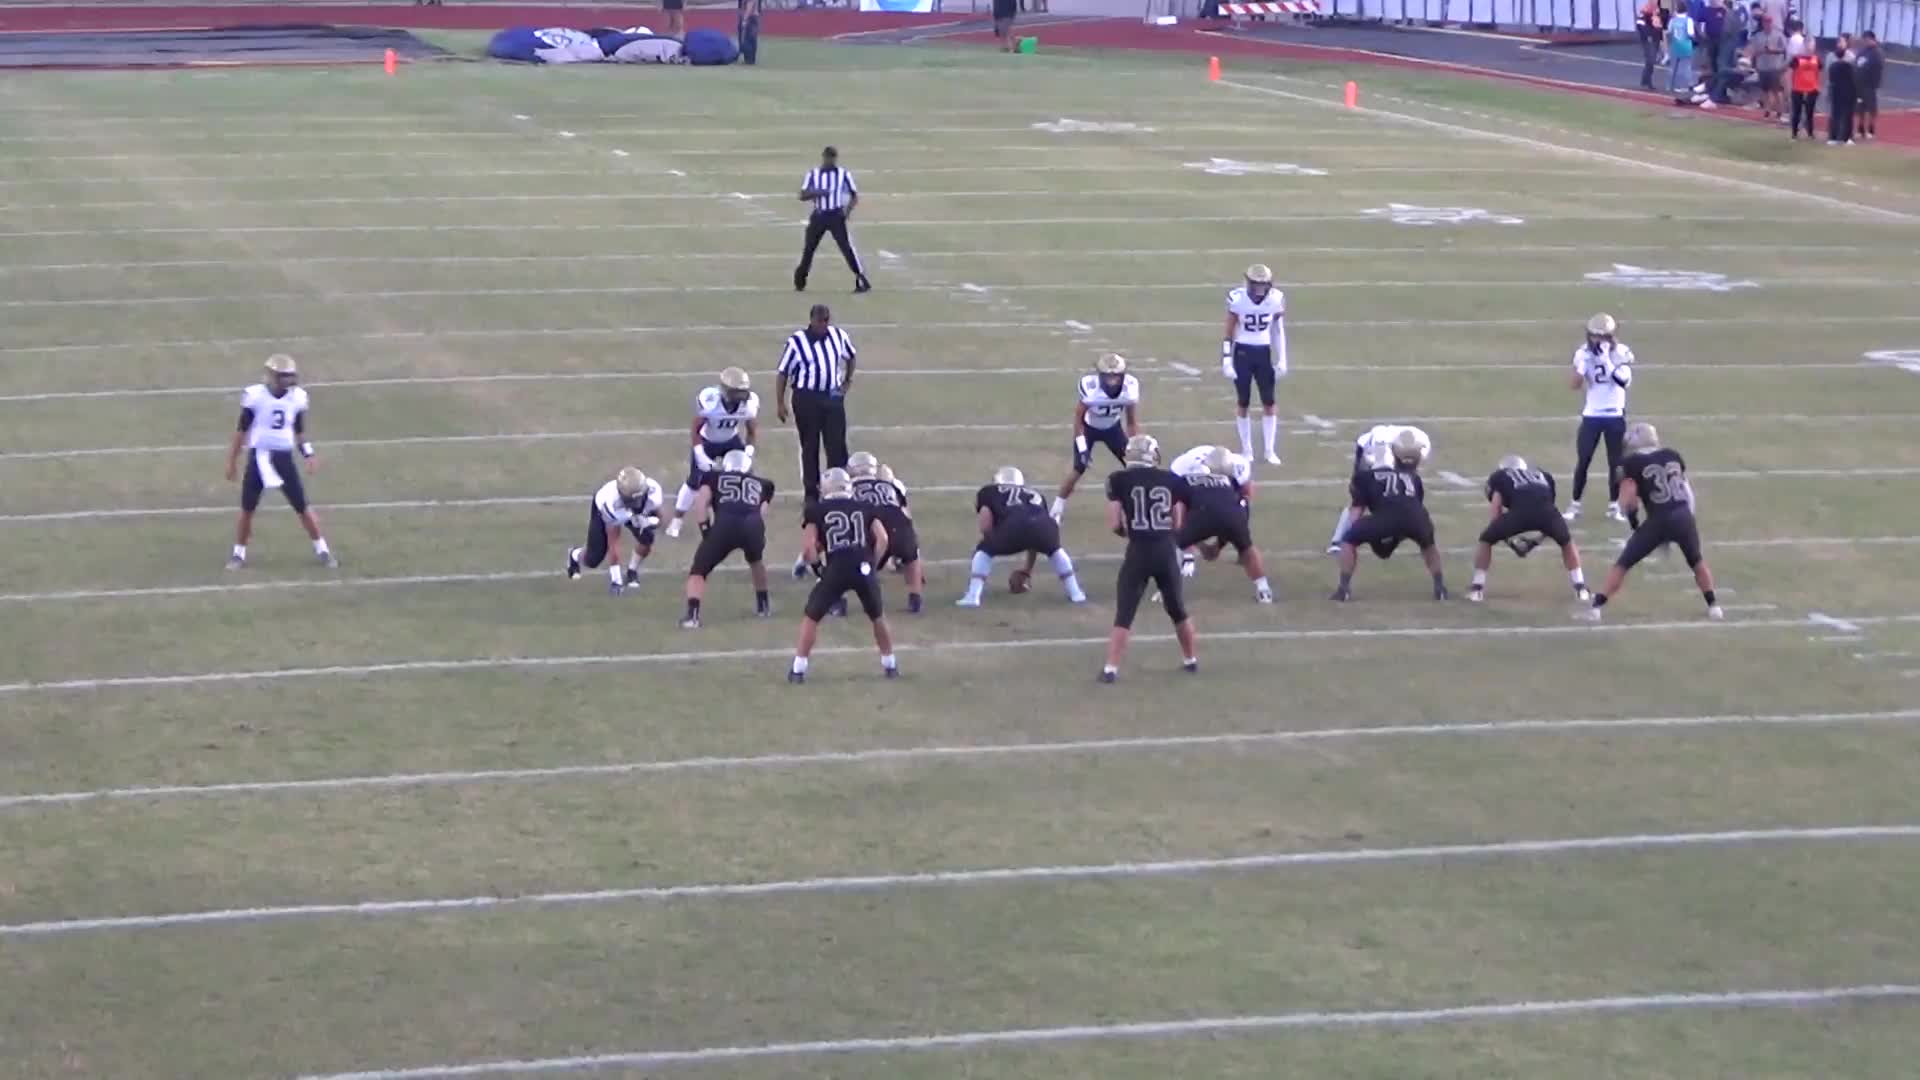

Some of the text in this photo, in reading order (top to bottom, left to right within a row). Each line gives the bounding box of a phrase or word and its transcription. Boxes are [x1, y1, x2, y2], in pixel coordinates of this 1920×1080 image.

[1244, 313, 1270, 332] 25
[271, 409, 286, 430] 3
[718, 475, 763, 506] 56
[1130, 486, 1173, 530] 12
[824, 511, 866, 553] 21
